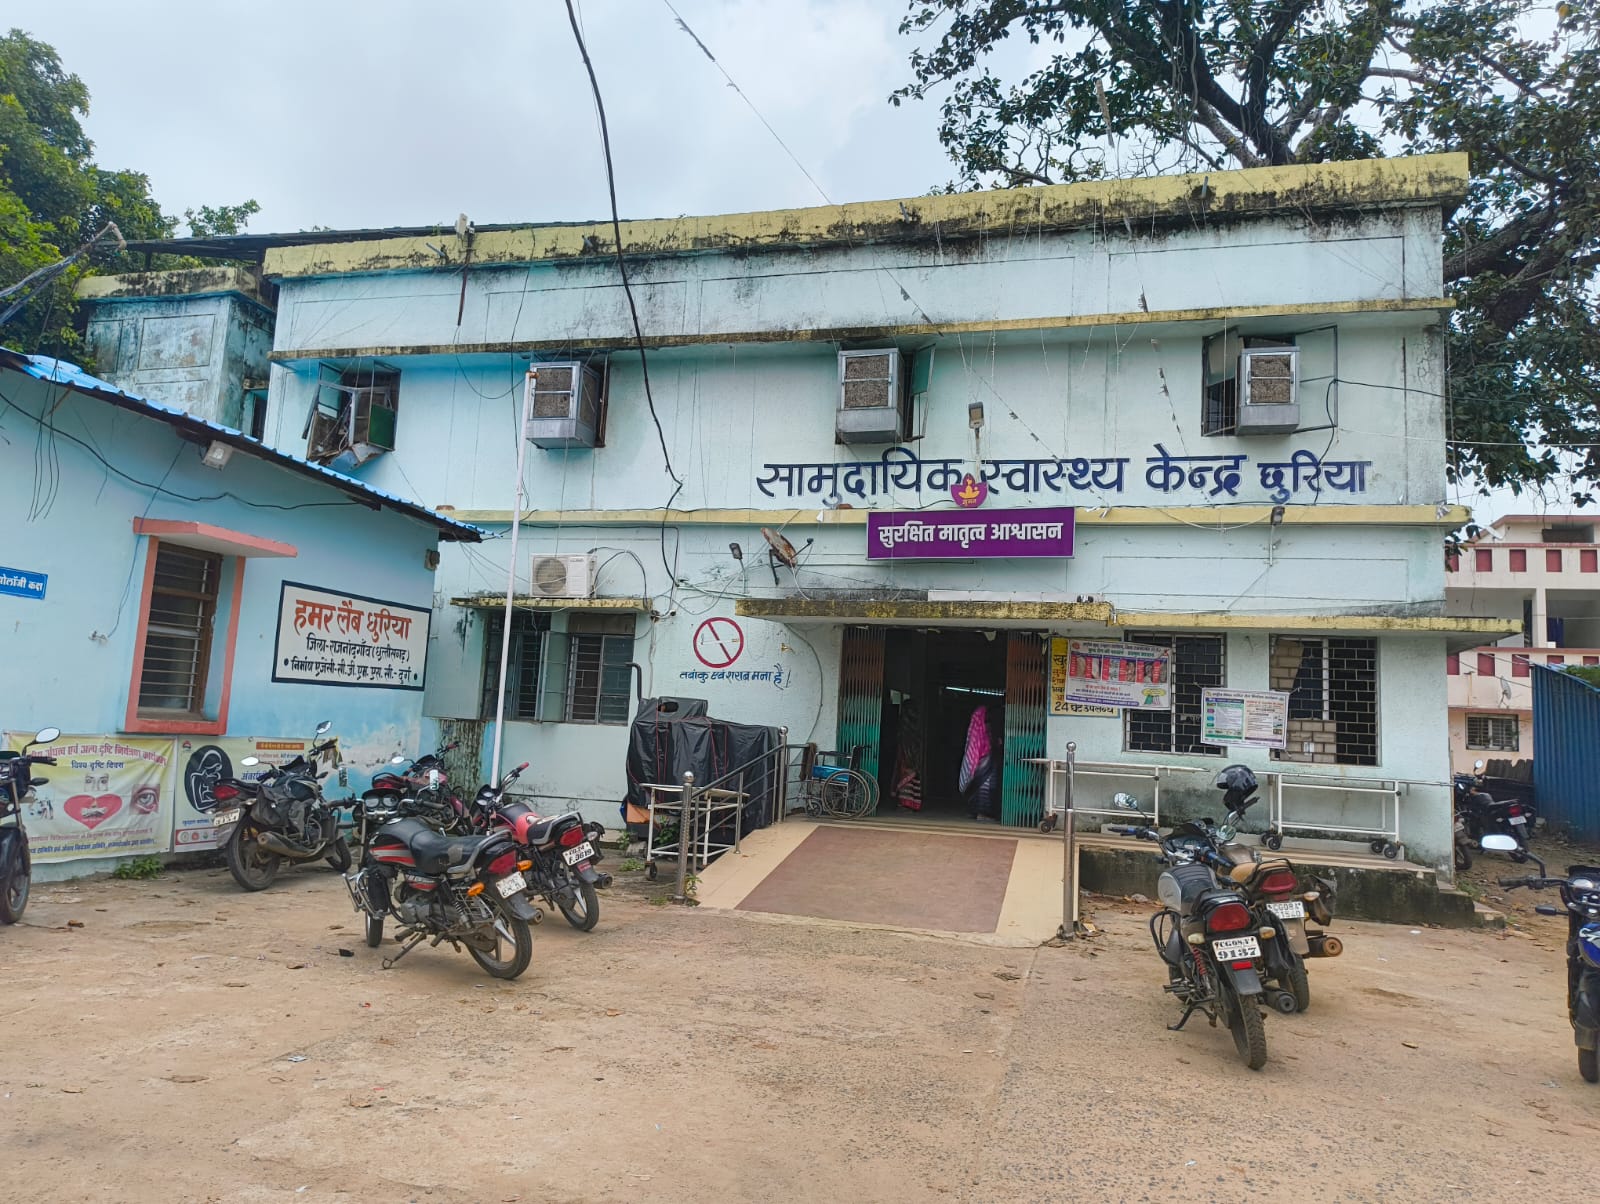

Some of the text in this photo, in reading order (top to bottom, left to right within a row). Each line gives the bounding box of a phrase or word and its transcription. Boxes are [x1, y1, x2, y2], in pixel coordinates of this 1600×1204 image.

[756, 443, 1371, 505] सामुदायिक स्वास्थ्य केन्द्र छुरिया
[878, 521, 1064, 548] सुरक्षित मातृत्व आश्वासन
[294, 599, 336, 636] हमर
[1054, 702, 1069, 712] 24
